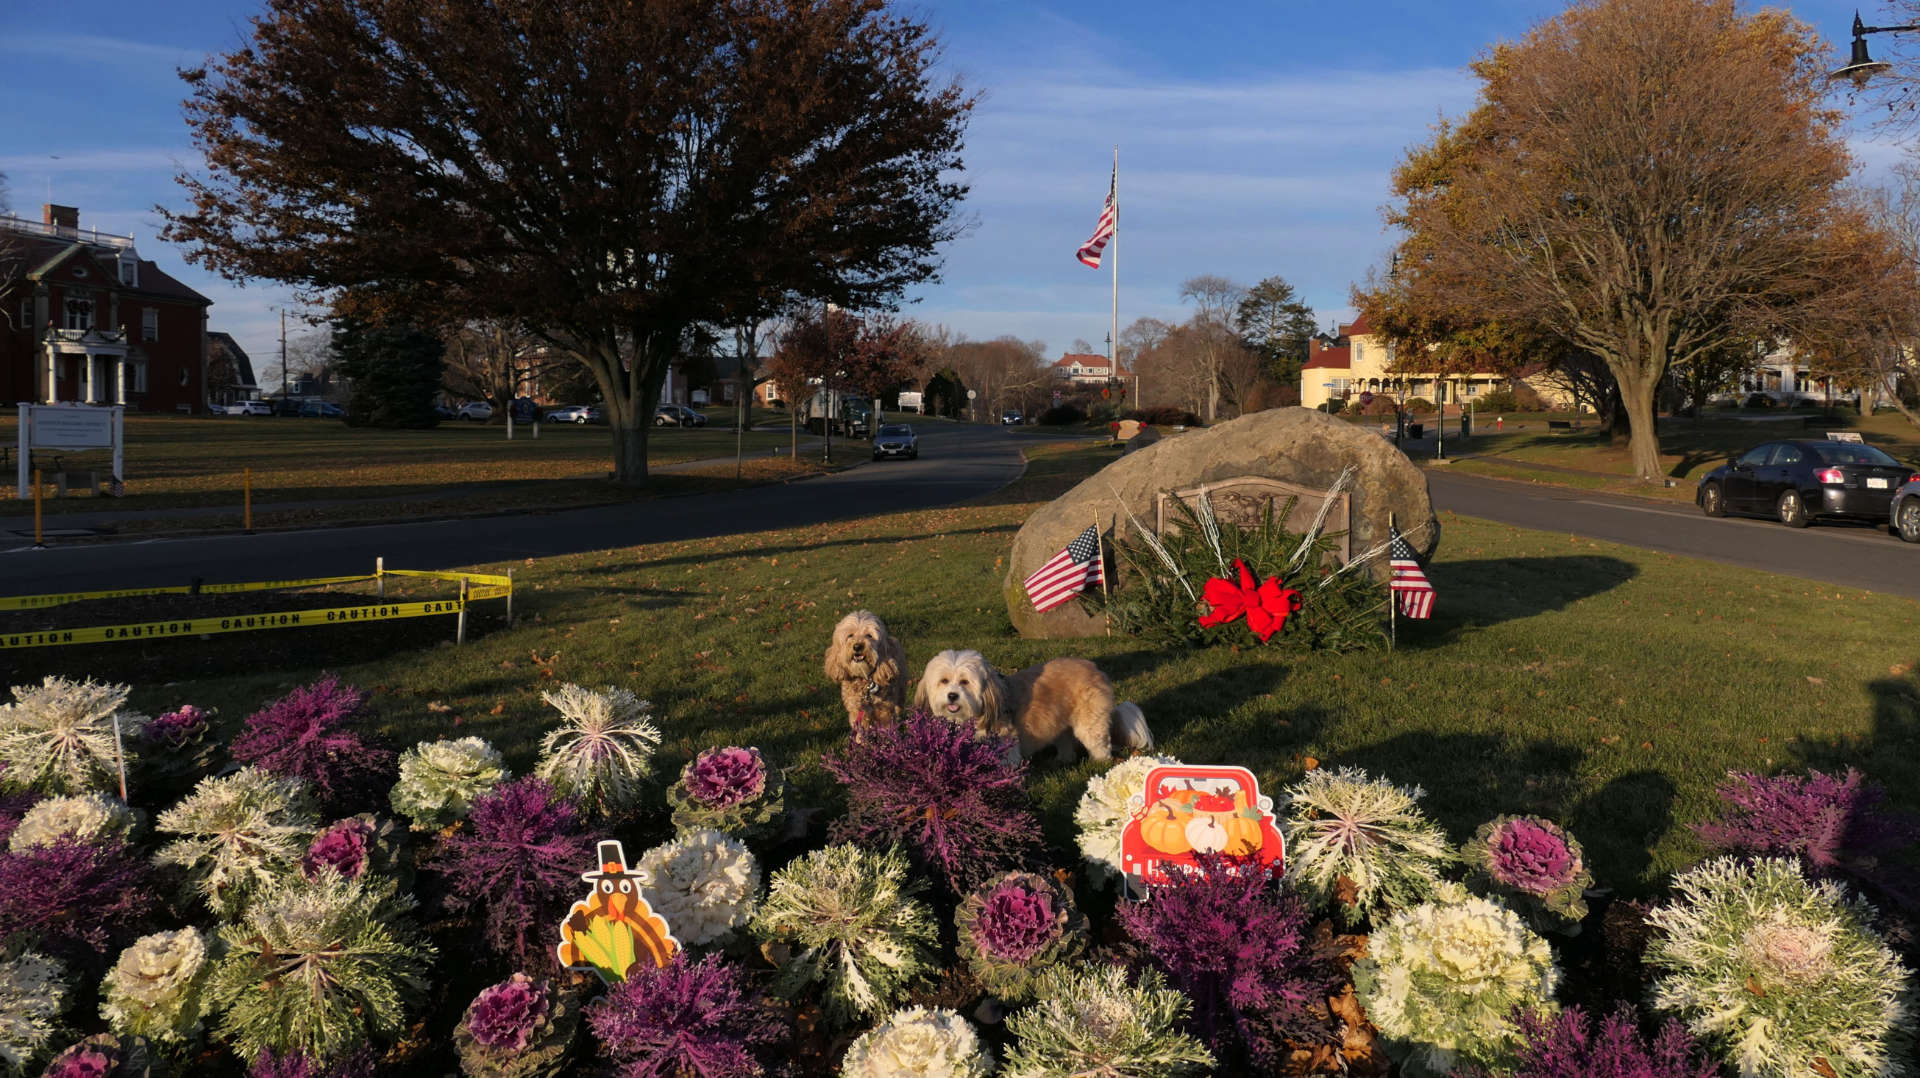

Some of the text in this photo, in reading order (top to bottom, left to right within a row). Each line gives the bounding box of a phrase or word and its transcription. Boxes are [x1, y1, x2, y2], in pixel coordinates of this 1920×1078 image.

[105, 622, 192, 639] CAUTION
[221, 613, 300, 629] CAUTION
[327, 605, 400, 621] CAUTION
